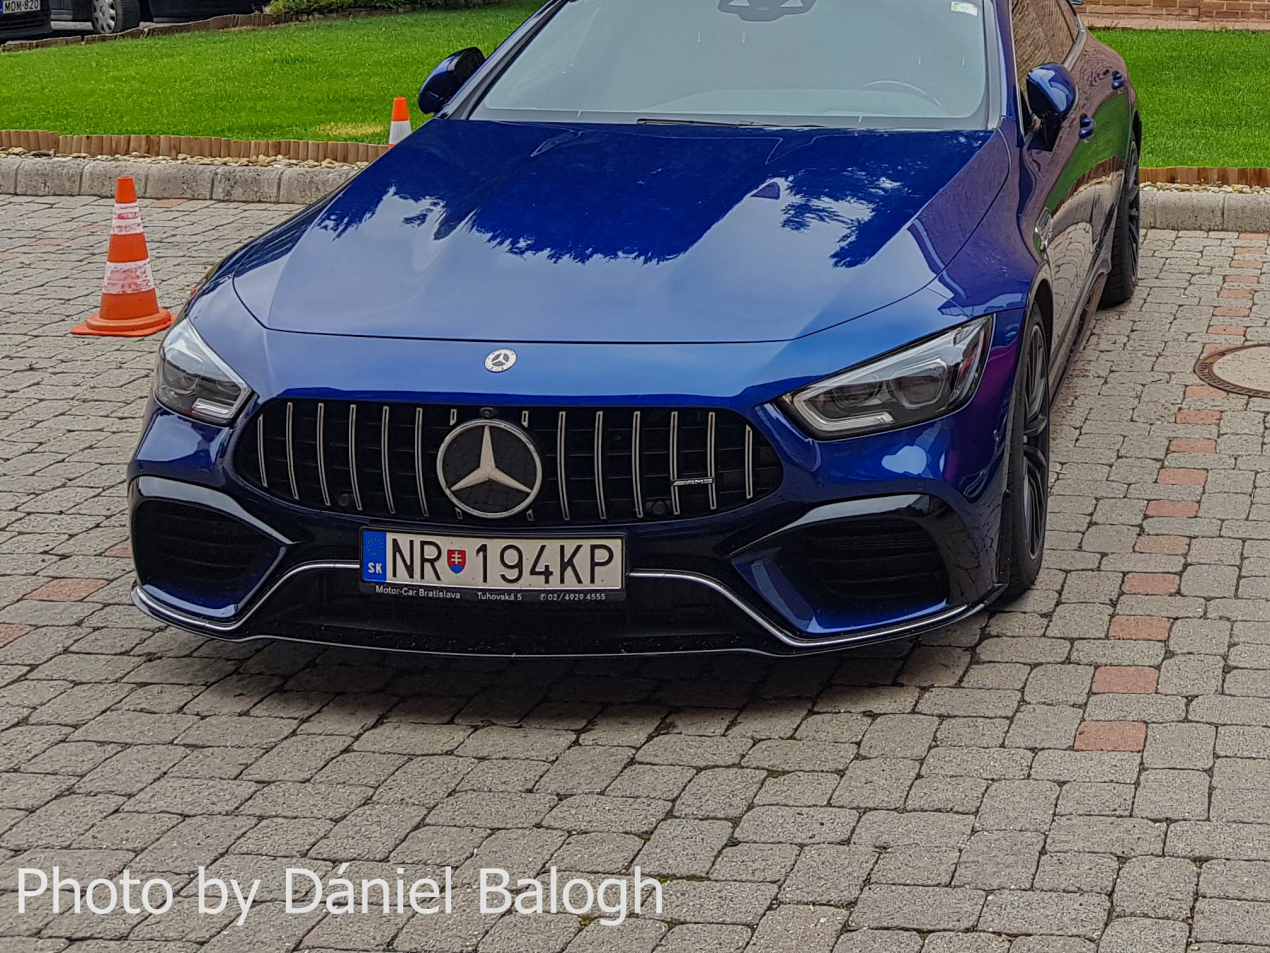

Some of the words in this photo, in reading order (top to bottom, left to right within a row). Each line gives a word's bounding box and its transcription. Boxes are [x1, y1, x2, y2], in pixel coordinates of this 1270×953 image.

[4, 0, 39, 12] MOM-820
[391, 538, 442, 581] NR
[475, 543, 614, 584] 194KP
[367, 562, 383, 574] SK
[375, 585, 417, 596] Motor-Car
[418, 588, 461, 599] Bratislava
[477, 592, 515, 601] Tuhovská
[516, 593, 522, 601] 5
[585, 593, 606, 601] 4555
